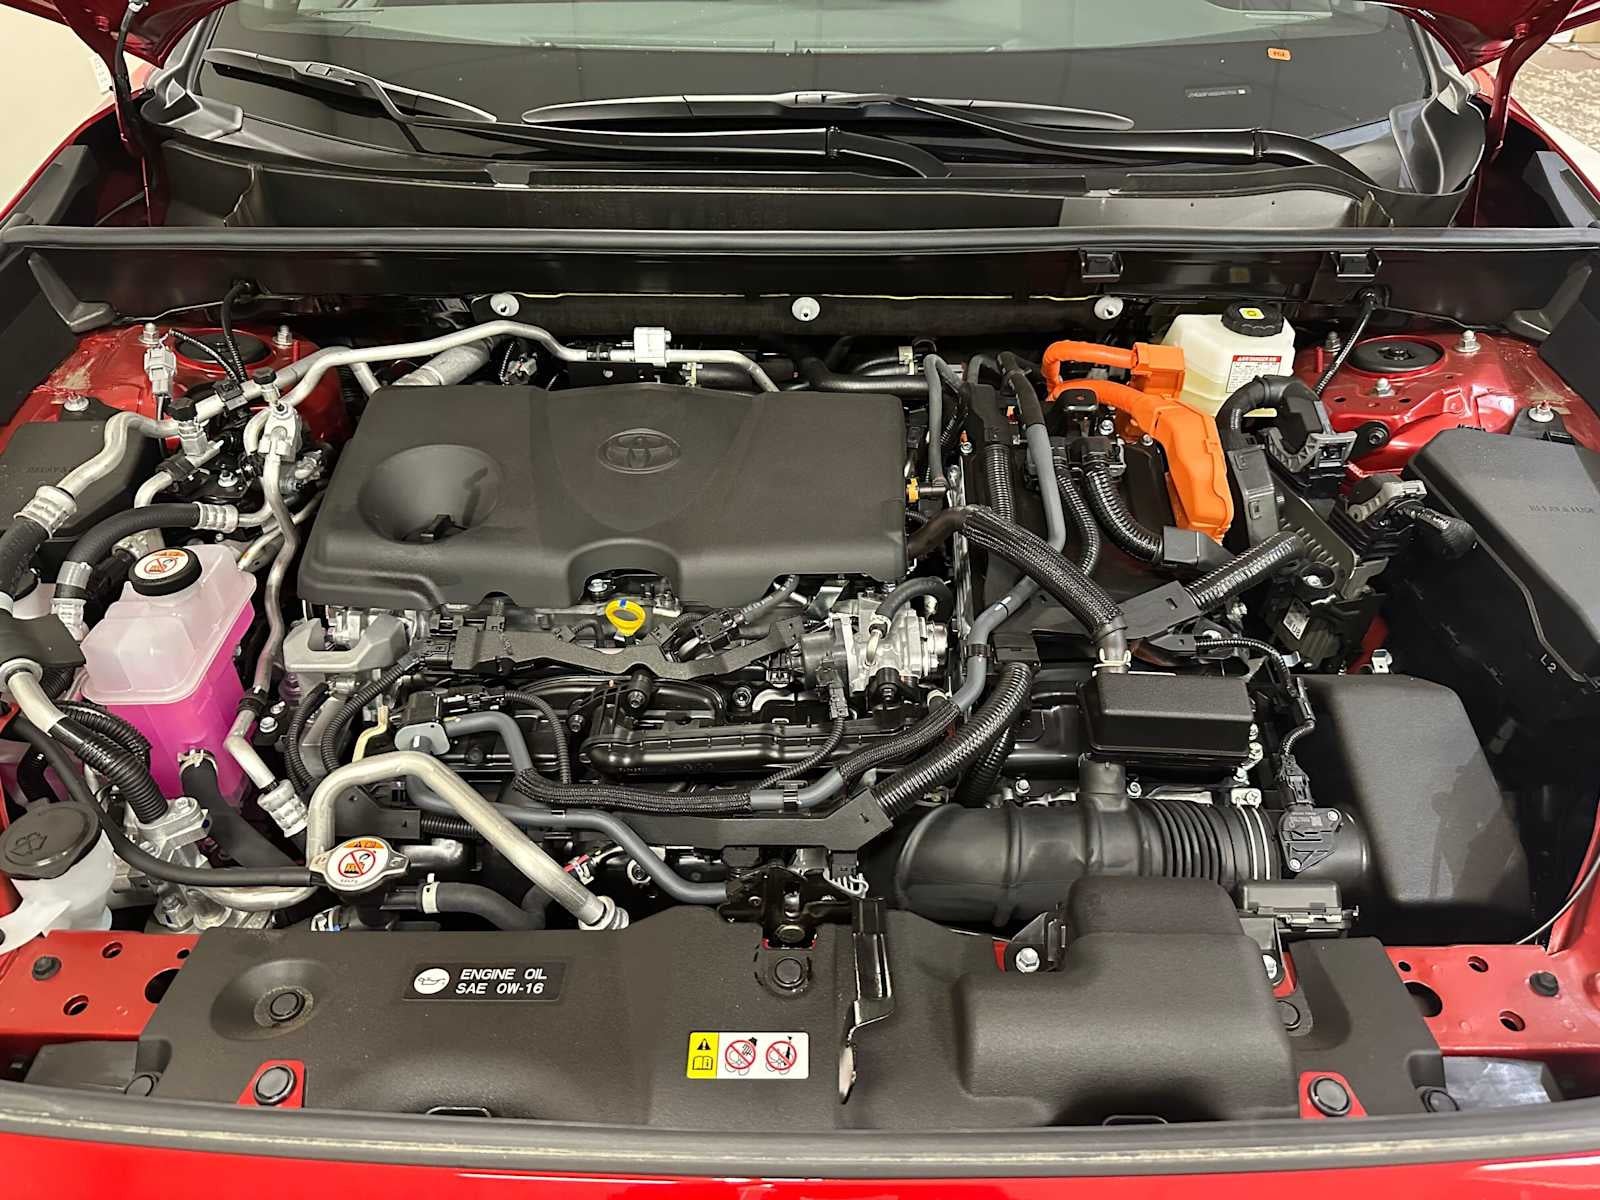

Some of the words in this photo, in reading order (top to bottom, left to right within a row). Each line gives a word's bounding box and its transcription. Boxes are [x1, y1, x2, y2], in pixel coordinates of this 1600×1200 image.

[460, 968, 516, 980] ENGINE
[524, 968, 548, 980] OIL
[455, 982, 488, 994] SAE
